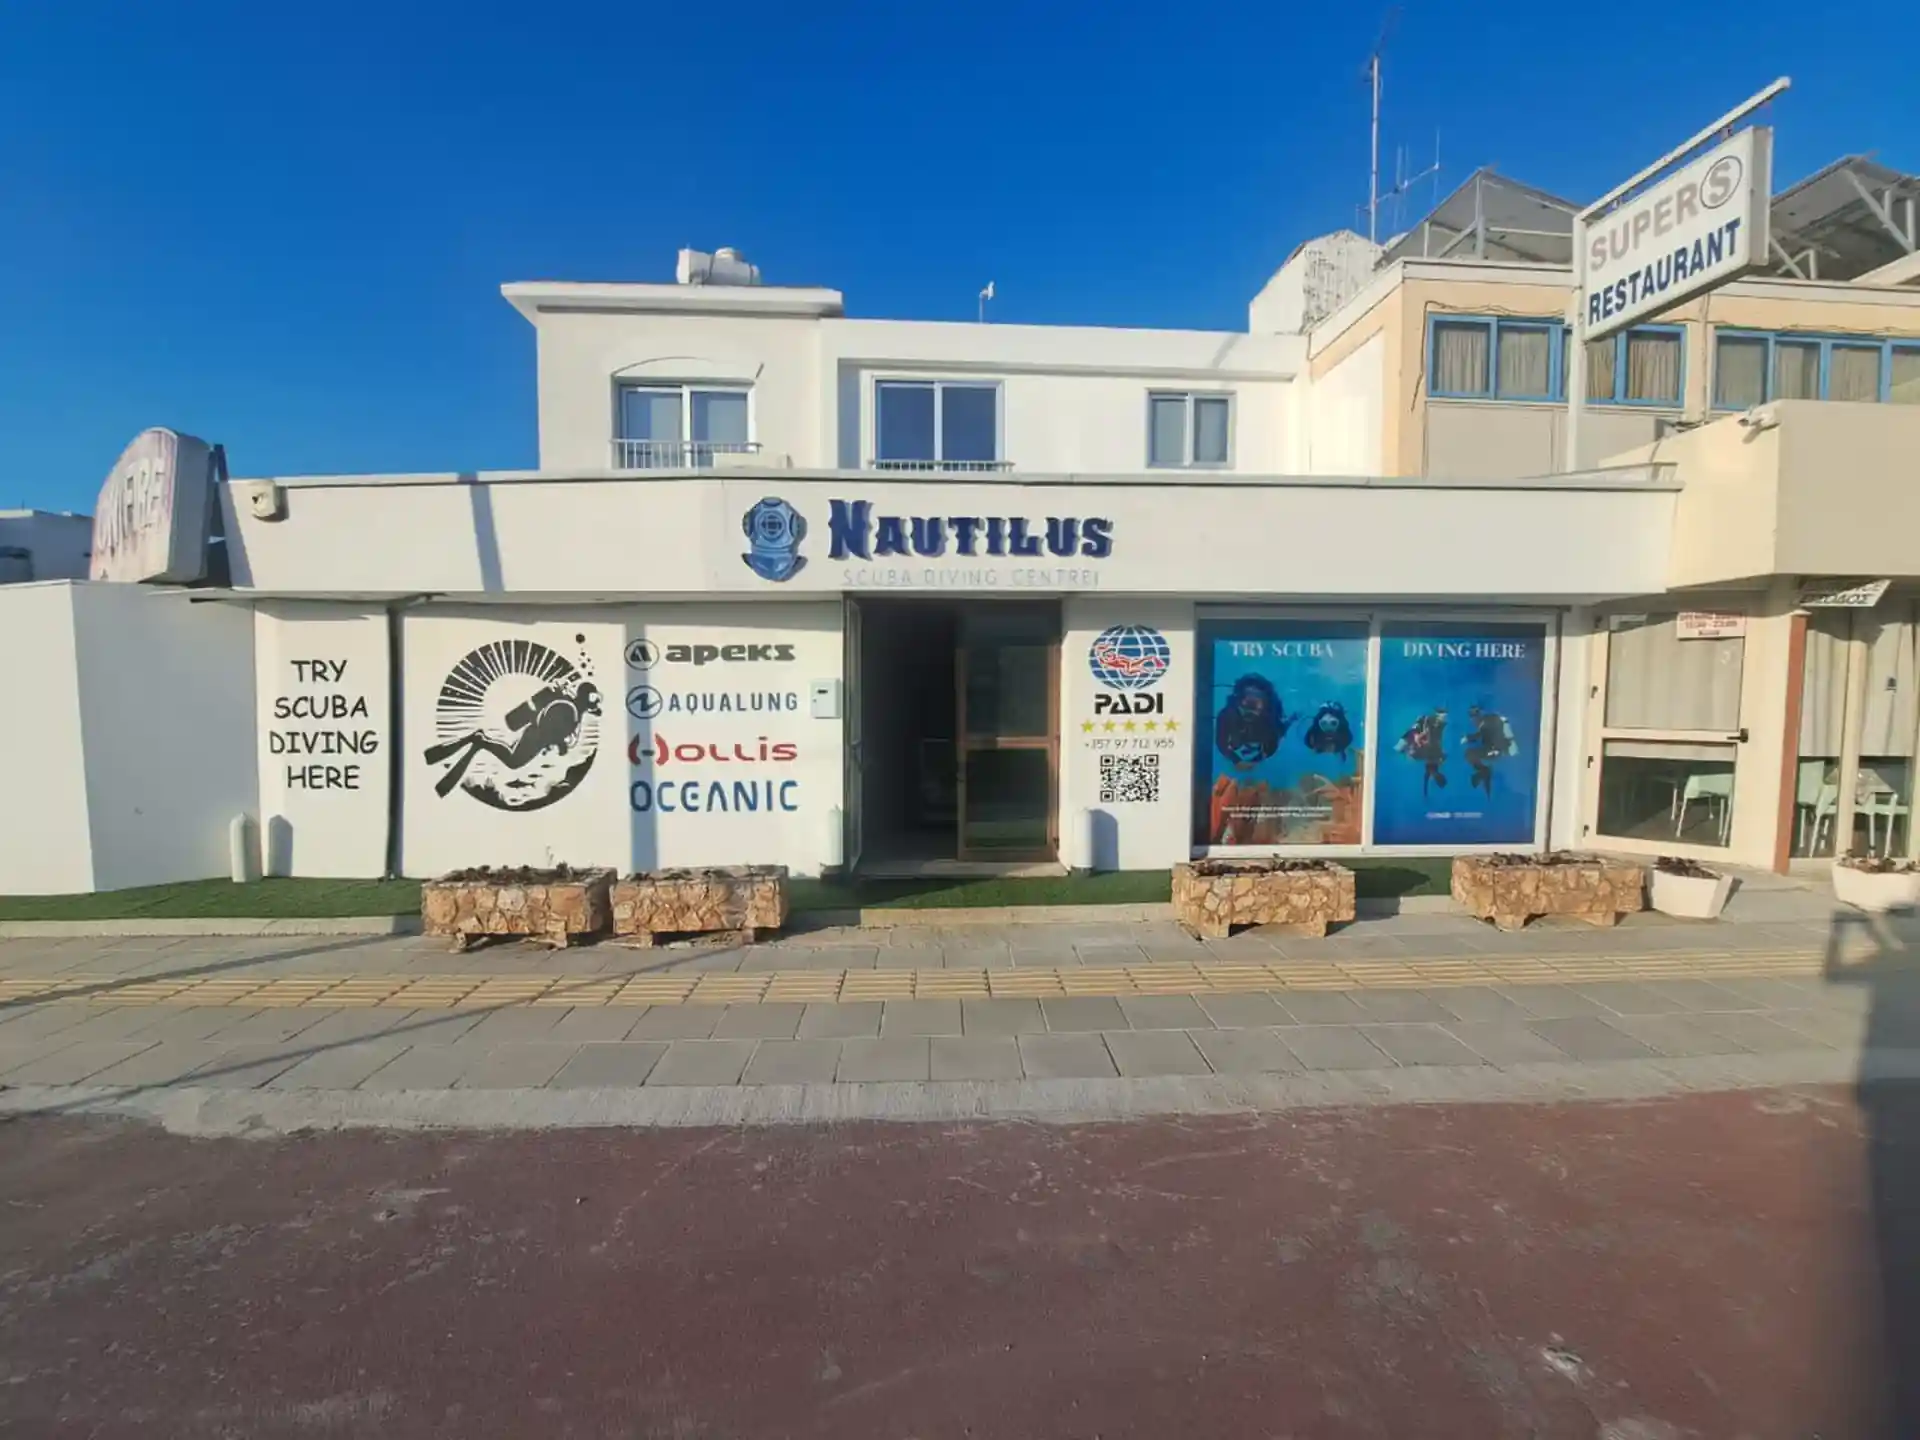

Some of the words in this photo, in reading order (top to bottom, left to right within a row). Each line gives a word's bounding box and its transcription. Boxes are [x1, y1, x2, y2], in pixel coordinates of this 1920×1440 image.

[1590, 182, 1699, 272] SUPER
[1588, 217, 1742, 327] RESTAURANT
[828, 499, 1114, 561] NAUTILUS
[842, 568, 913, 586] SCUBA
[923, 568, 998, 586] DIVING
[664, 643, 797, 666] apeks
[1229, 641, 1264, 657] TRY
[1271, 641, 1334, 658] SCUBA
[1403, 641, 1471, 659] DIVING
[1475, 642, 1526, 659] HERE
[290, 659, 348, 683] TRY
[274, 696, 369, 719] SCUBA
[668, 691, 799, 715] AQUALUNG
[1094, 692, 1164, 715] PADI
[269, 730, 379, 755] DIVING
[287, 764, 361, 790] HERE
[629, 779, 799, 813] OCEANIC
